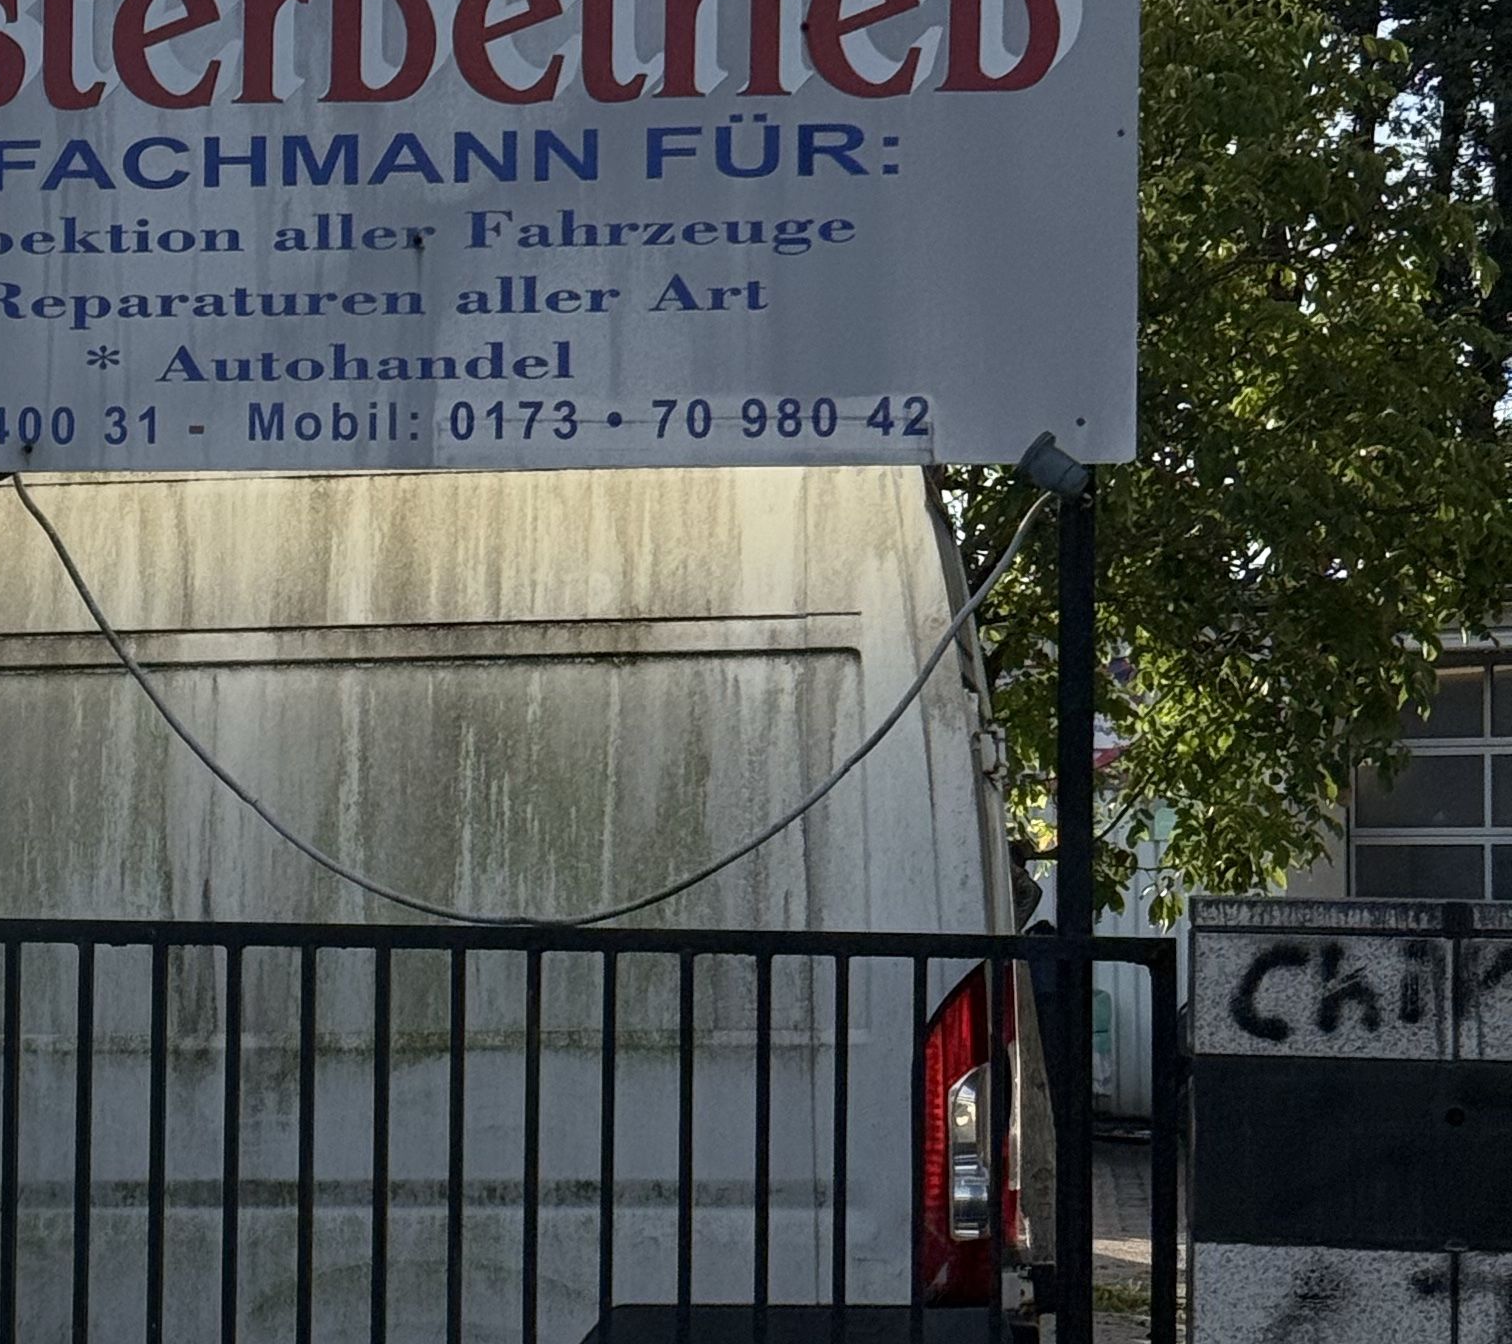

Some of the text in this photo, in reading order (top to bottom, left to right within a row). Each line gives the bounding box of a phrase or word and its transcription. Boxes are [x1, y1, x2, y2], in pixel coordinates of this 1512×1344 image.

[645, 113, 900, 180] FÜR:
[273, 212, 437, 253] aller
[464, 209, 856, 256] Fahrzeuge
[455, 274, 621, 315] aller
[647, 273, 769, 312] Art
[154, 340, 575, 383] Autohandel
[103, 405, 156, 446] 31
[248, 401, 420, 443] Mobil:
[449, 399, 581, 441] 0173
[651, 398, 715, 440] 70
[741, 397, 839, 439] 980
[866, 396, 930, 438] 42
